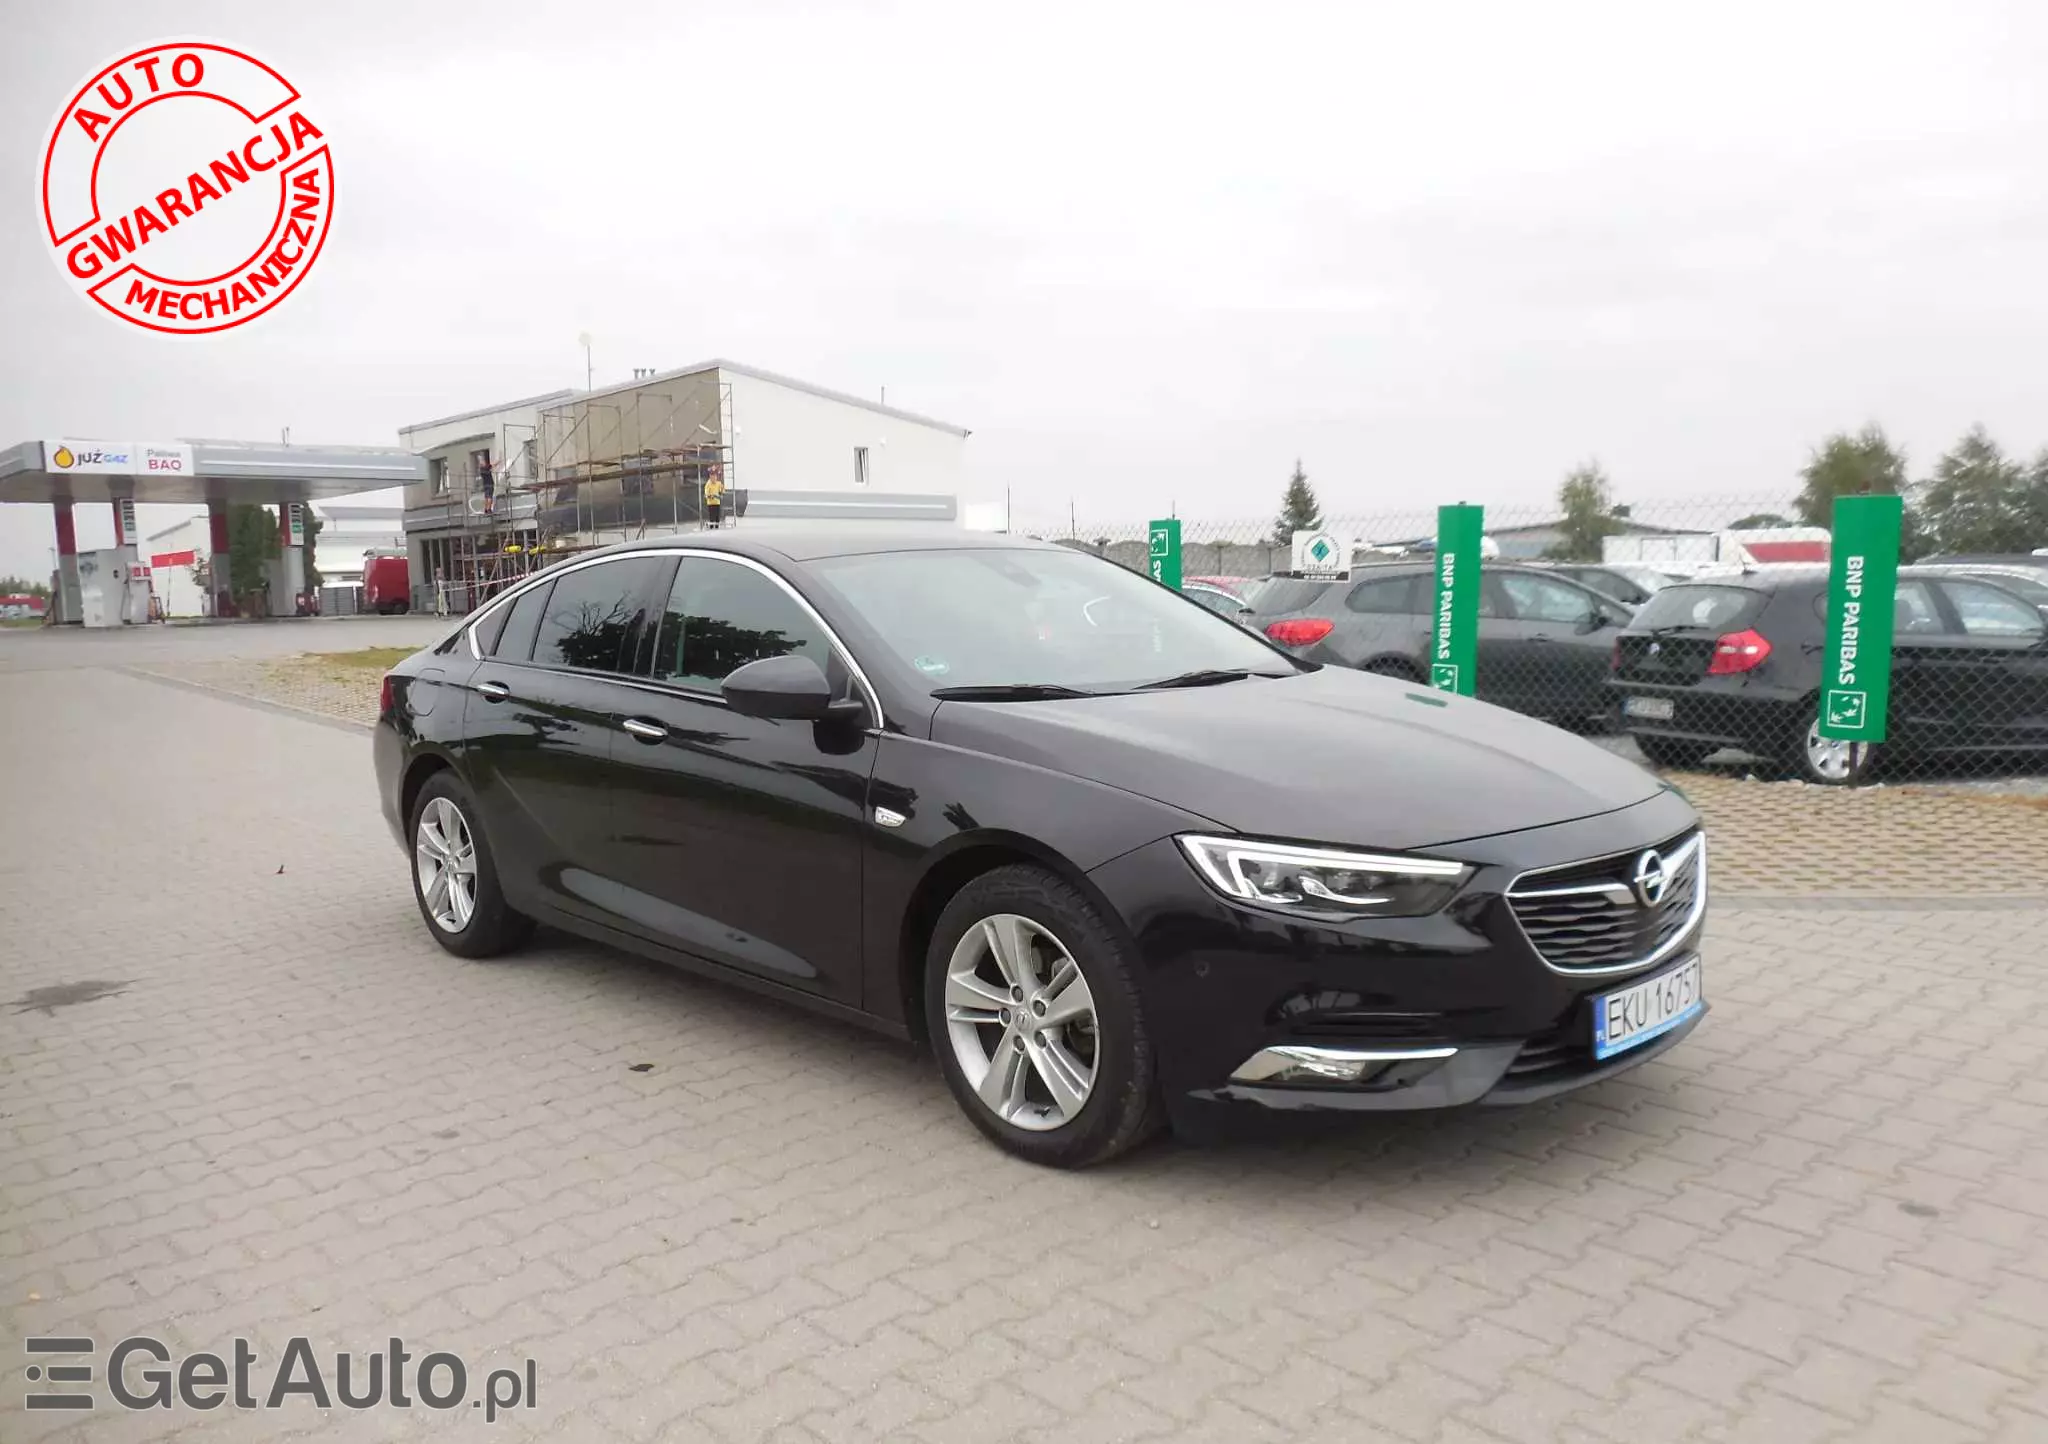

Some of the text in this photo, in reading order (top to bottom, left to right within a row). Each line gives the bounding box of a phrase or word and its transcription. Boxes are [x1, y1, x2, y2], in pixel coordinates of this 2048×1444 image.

[1438, 552, 1455, 660] BNP PARIBAS
[1838, 555, 1865, 686] BNP PARIBAS
[1608, 962, 1698, 1040] EKU 16757
